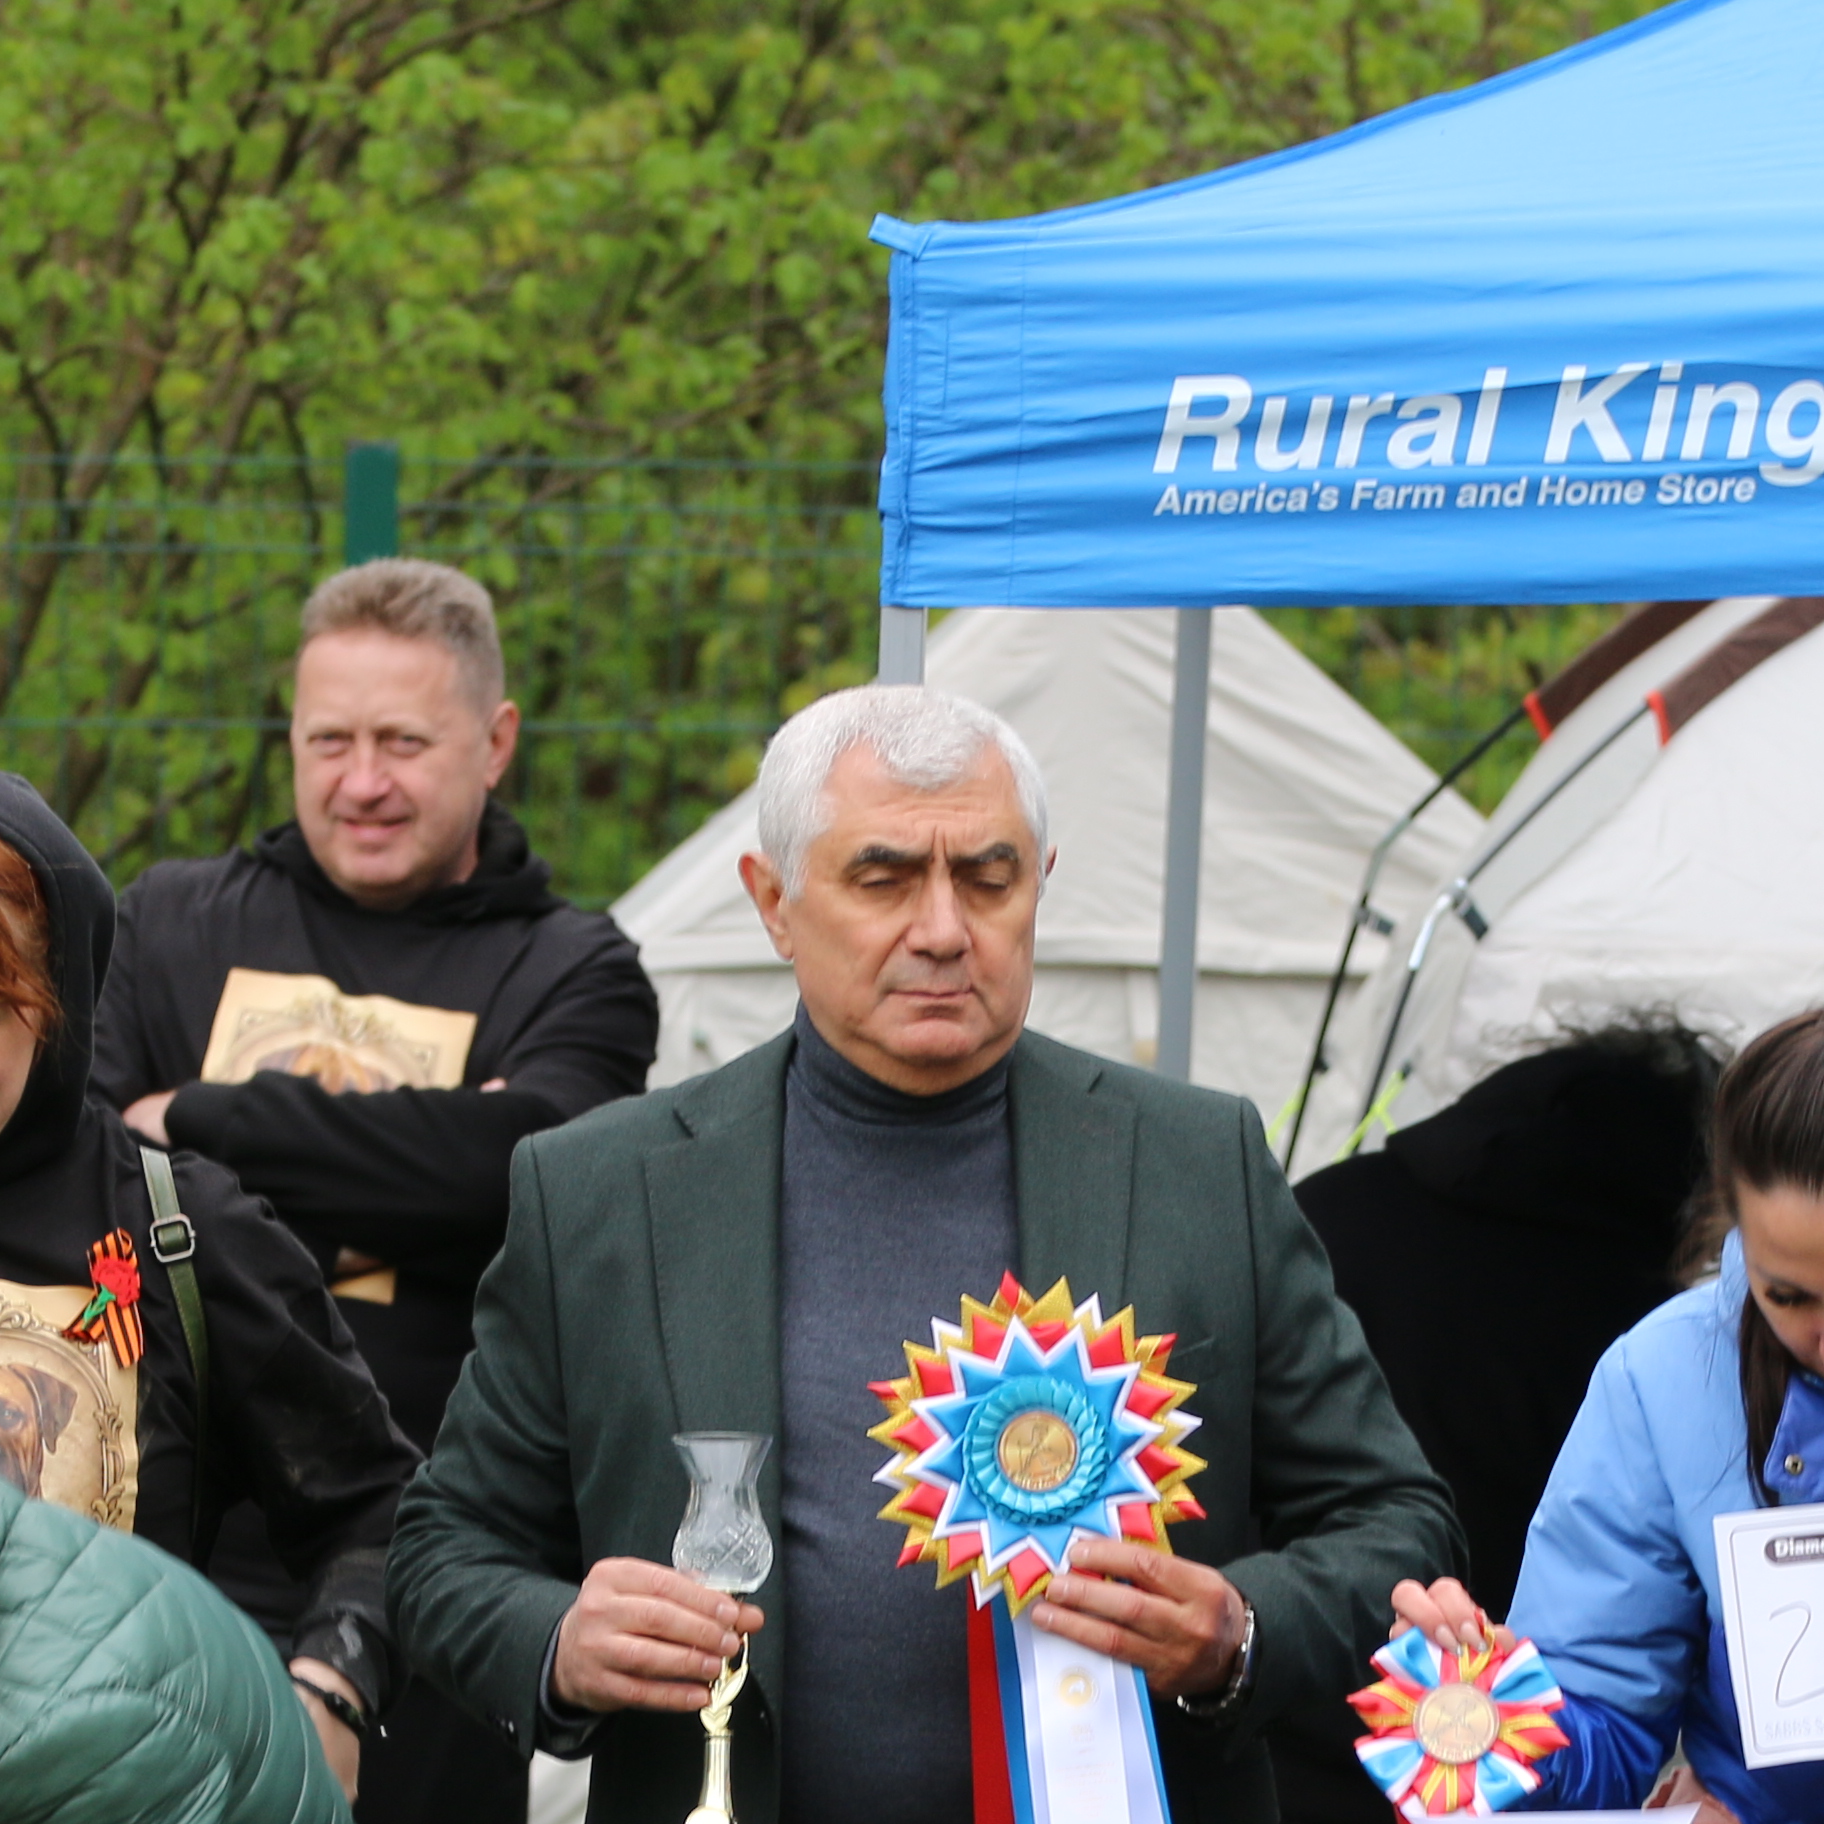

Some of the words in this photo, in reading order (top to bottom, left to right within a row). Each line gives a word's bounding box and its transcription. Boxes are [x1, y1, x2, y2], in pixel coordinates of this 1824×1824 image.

[1153, 366, 1508, 474] Rural
[1153, 481, 1339, 517] America's
[1350, 478, 1446, 511] Farm
[1456, 476, 1529, 509] and
[1536, 475, 1646, 507] Home
[1656, 473, 1757, 505] Store
